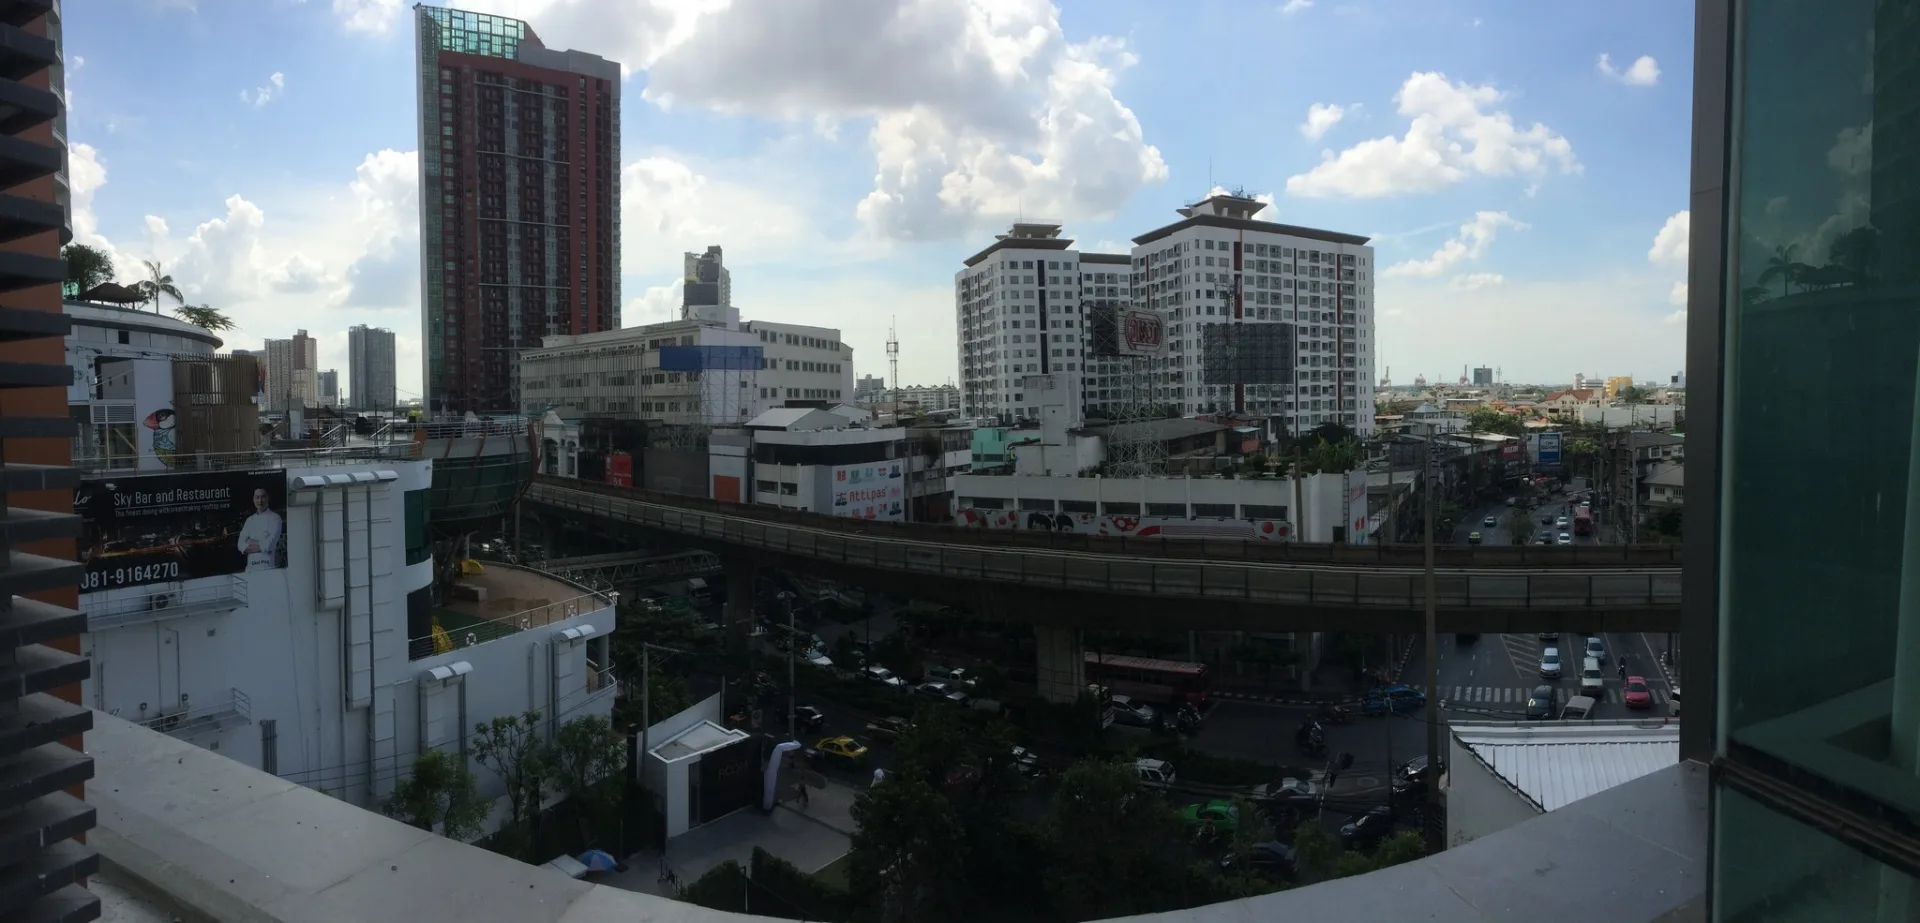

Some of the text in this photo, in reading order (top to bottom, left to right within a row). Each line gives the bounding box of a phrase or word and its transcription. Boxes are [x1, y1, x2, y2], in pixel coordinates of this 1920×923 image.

[114, 486, 231, 507] Sky Bar and Restaurant
[849, 487, 886, 502] Attipas
